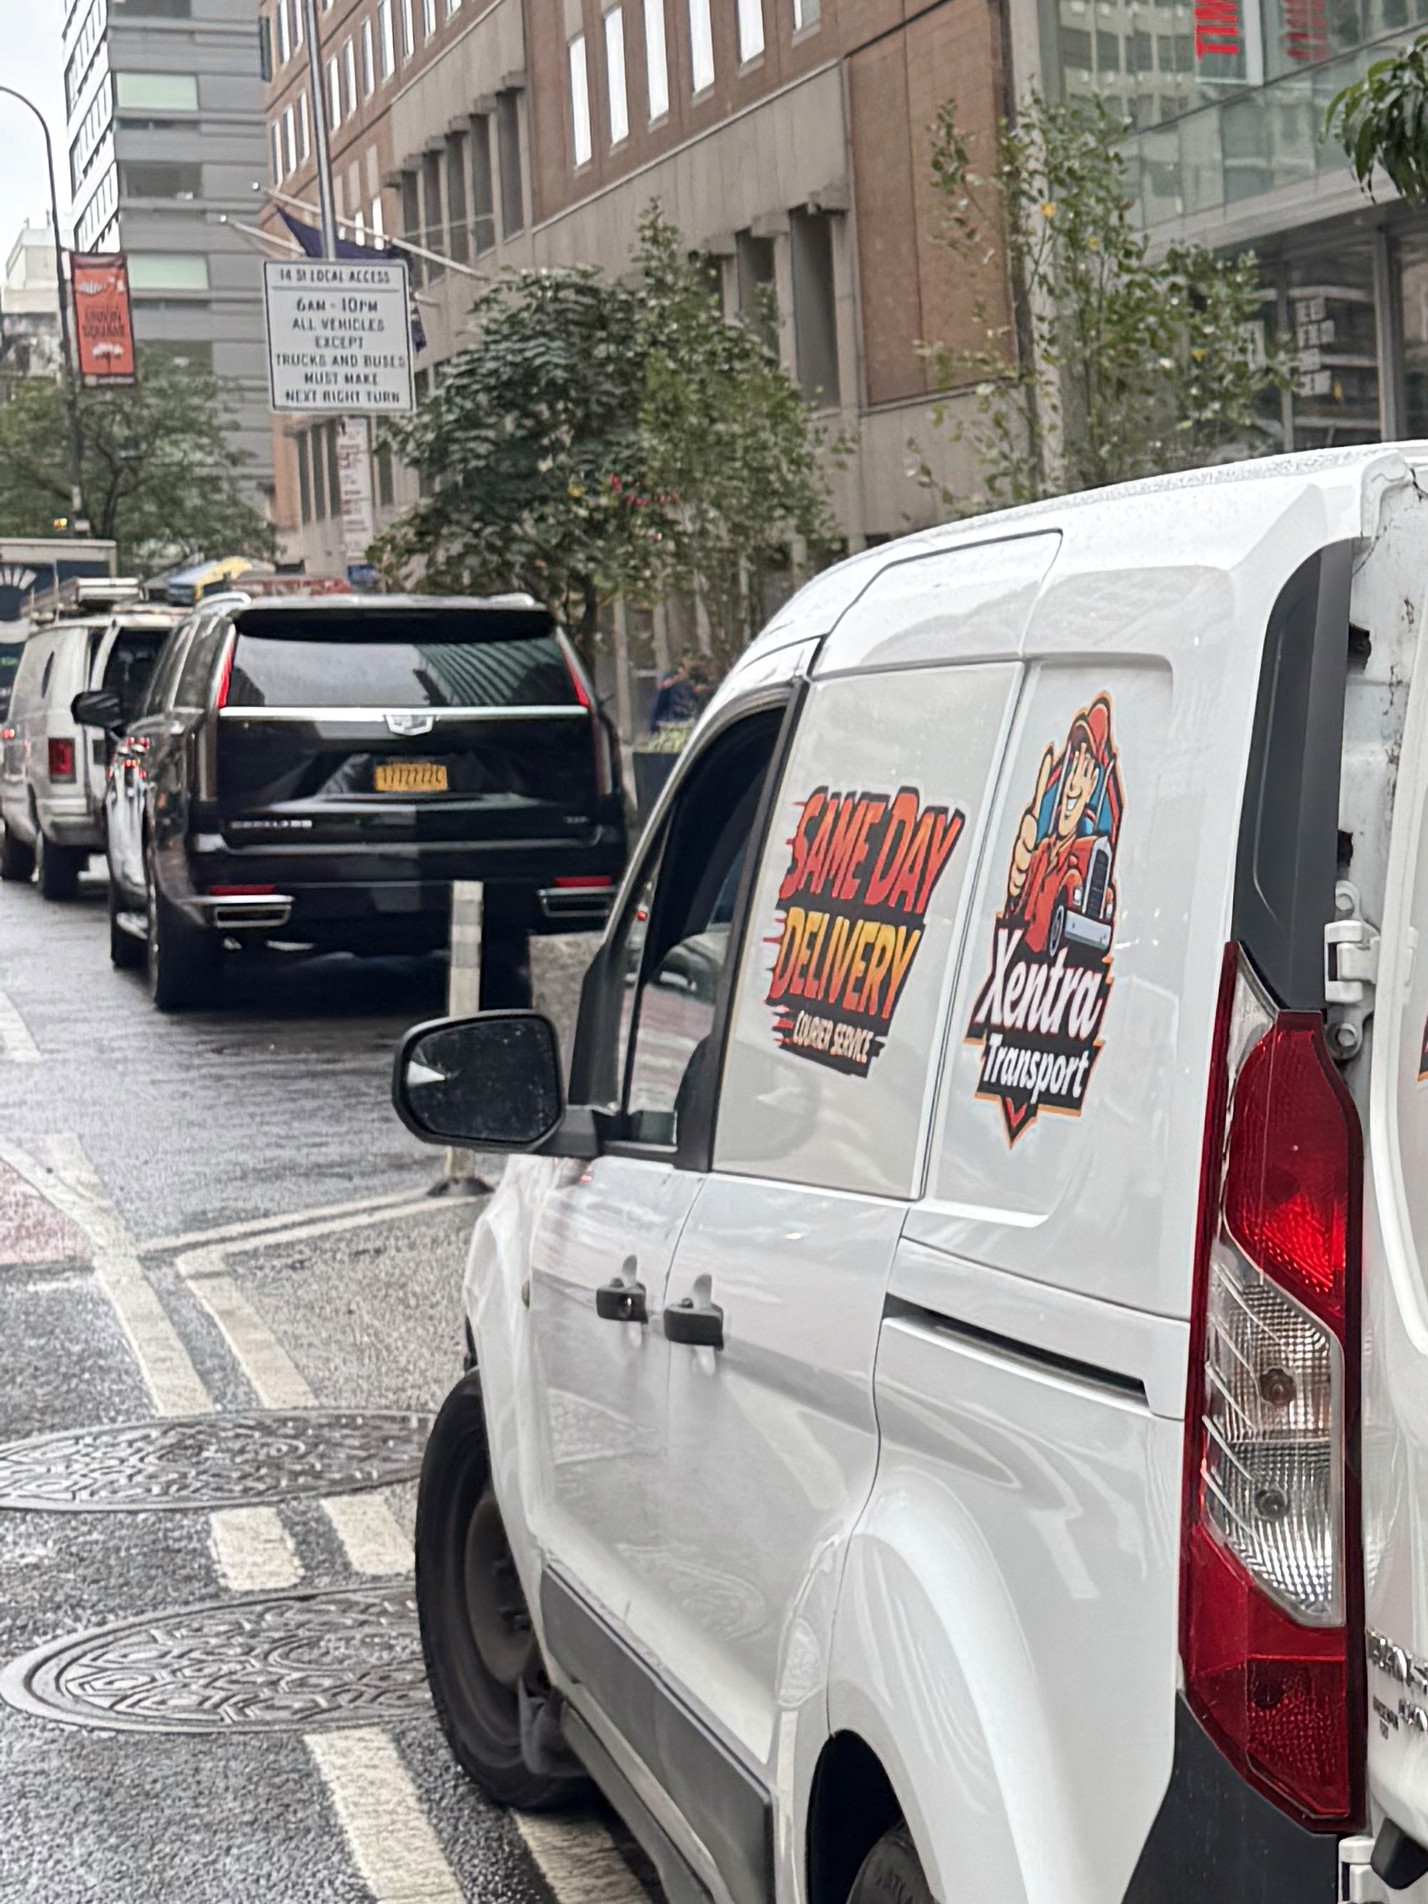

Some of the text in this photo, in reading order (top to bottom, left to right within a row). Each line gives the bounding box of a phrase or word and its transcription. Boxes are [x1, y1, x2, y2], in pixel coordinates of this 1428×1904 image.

[280, 268, 292, 281] 14
[310, 269, 344, 283] LOCAL
[349, 270, 391, 284] ACCESS
[296, 297, 326, 313] 6AM
[341, 297, 378, 313] 10PM
[292, 318, 385, 332] ALL VEHICLES
[315, 336, 364, 349] EXCEPT
[275, 354, 406, 368] TRUCKS AND BUSES
[304, 371, 379, 385] MUST MAKE
[285, 390, 400, 403] NEXT RIGHT TURN
[779, 790, 963, 916] SAME DAY
[770, 907, 921, 1020] DELIVERY
[976, 926, 1104, 1042] Xentra
[792, 1008, 874, 1063] COURIER SERVICE
[983, 1034, 1090, 1103] Transport
